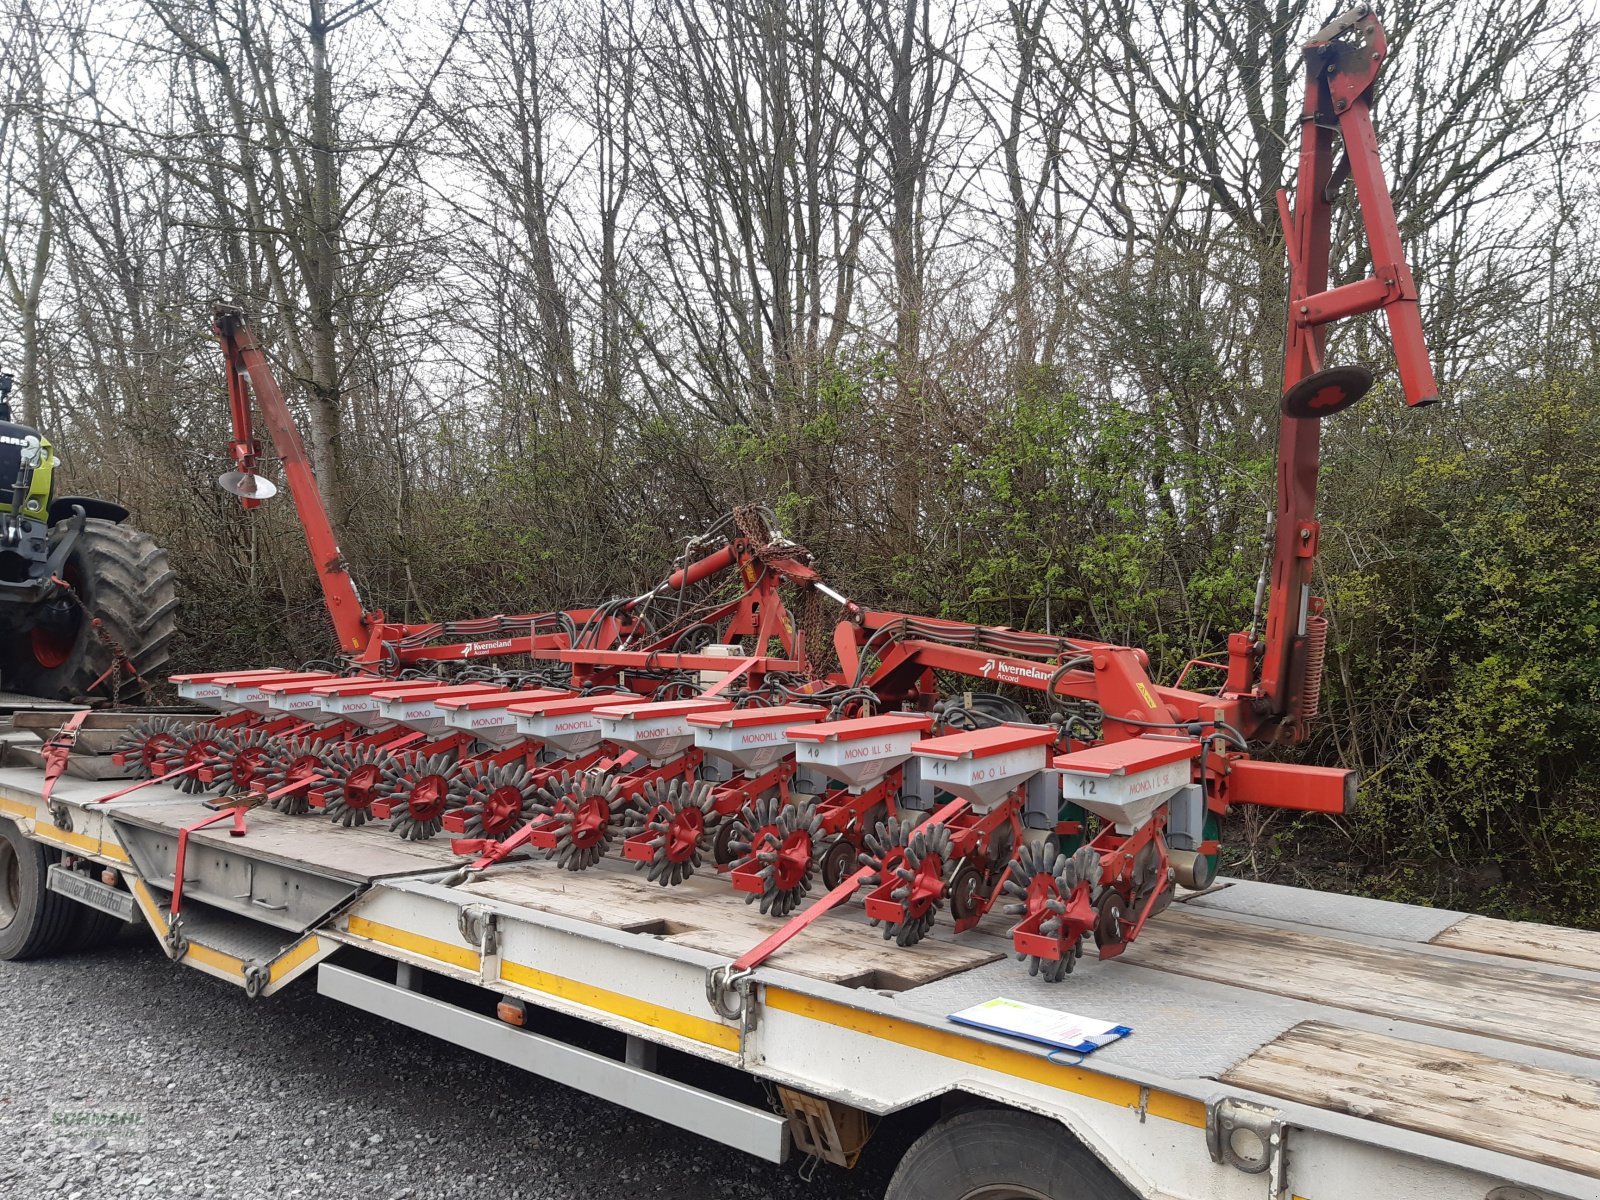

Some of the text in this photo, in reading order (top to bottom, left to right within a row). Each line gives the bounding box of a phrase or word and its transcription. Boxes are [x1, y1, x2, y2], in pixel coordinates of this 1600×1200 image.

[474, 639, 512, 651] Kverneland
[997, 672, 1019, 683] Accord
[708, 728, 713, 741] 9
[741, 731, 777, 744] MONOPILL
[808, 747, 820, 758] 10
[884, 743, 892, 752] SE
[933, 761, 947, 776] 11
[1079, 778, 1096, 797] 12
